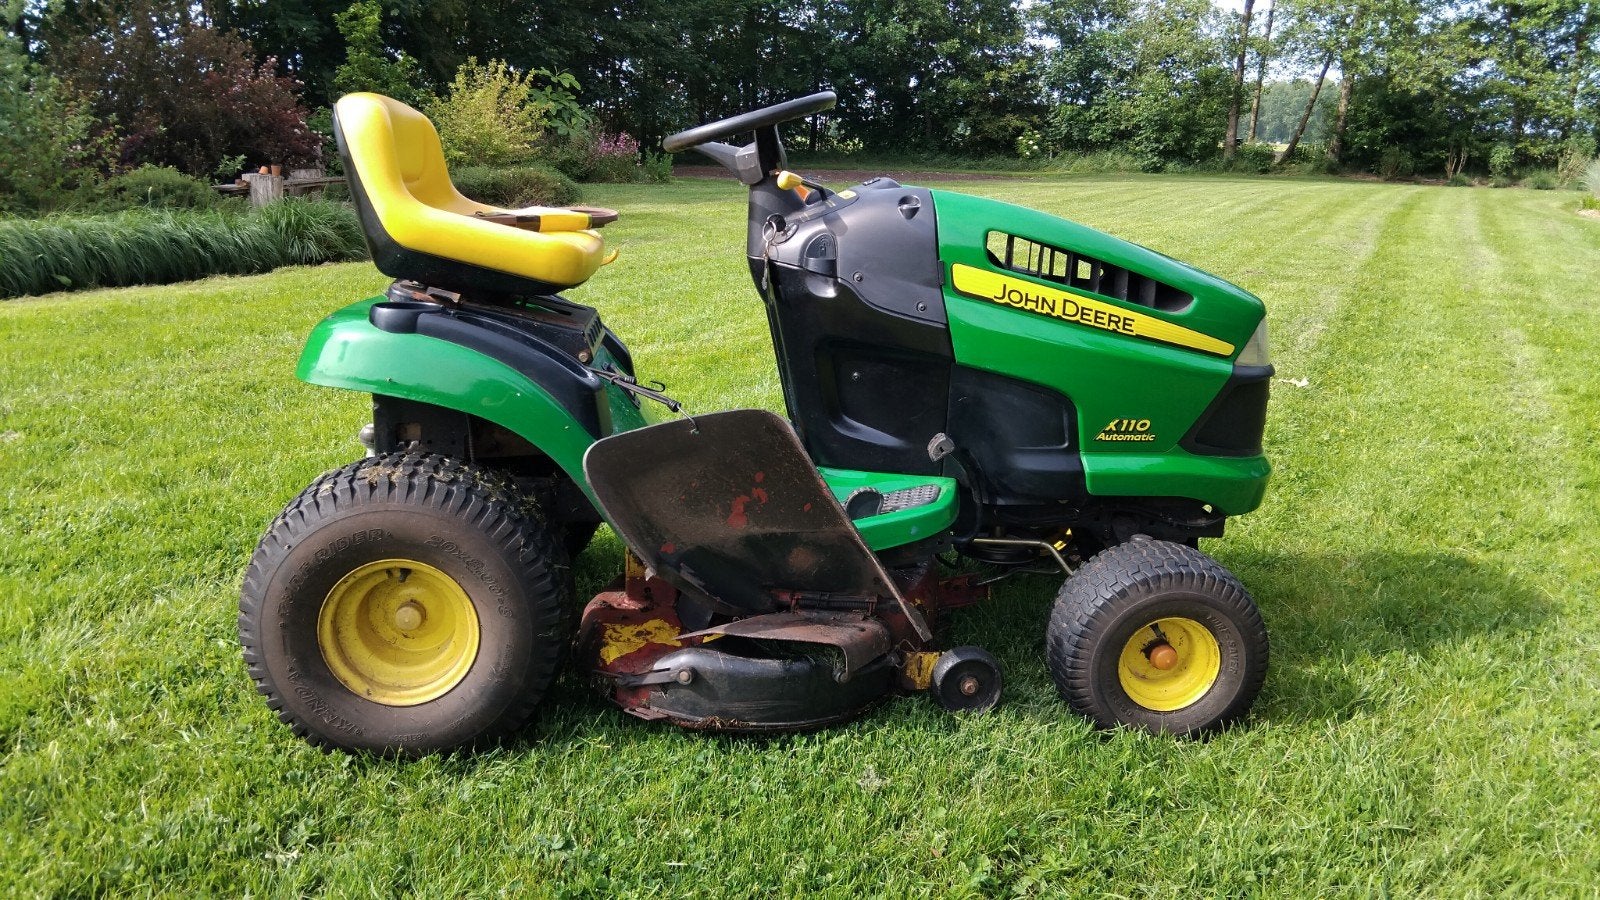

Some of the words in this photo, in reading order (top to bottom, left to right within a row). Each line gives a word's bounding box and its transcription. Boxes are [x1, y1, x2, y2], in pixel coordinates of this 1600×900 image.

[994, 284, 1056, 313] JOHN
[1062, 298, 1135, 333] DEERE
[1095, 432, 1156, 441] Automatic
[1104, 419, 1151, 431] X110
[314, 527, 384, 562] RIDER
